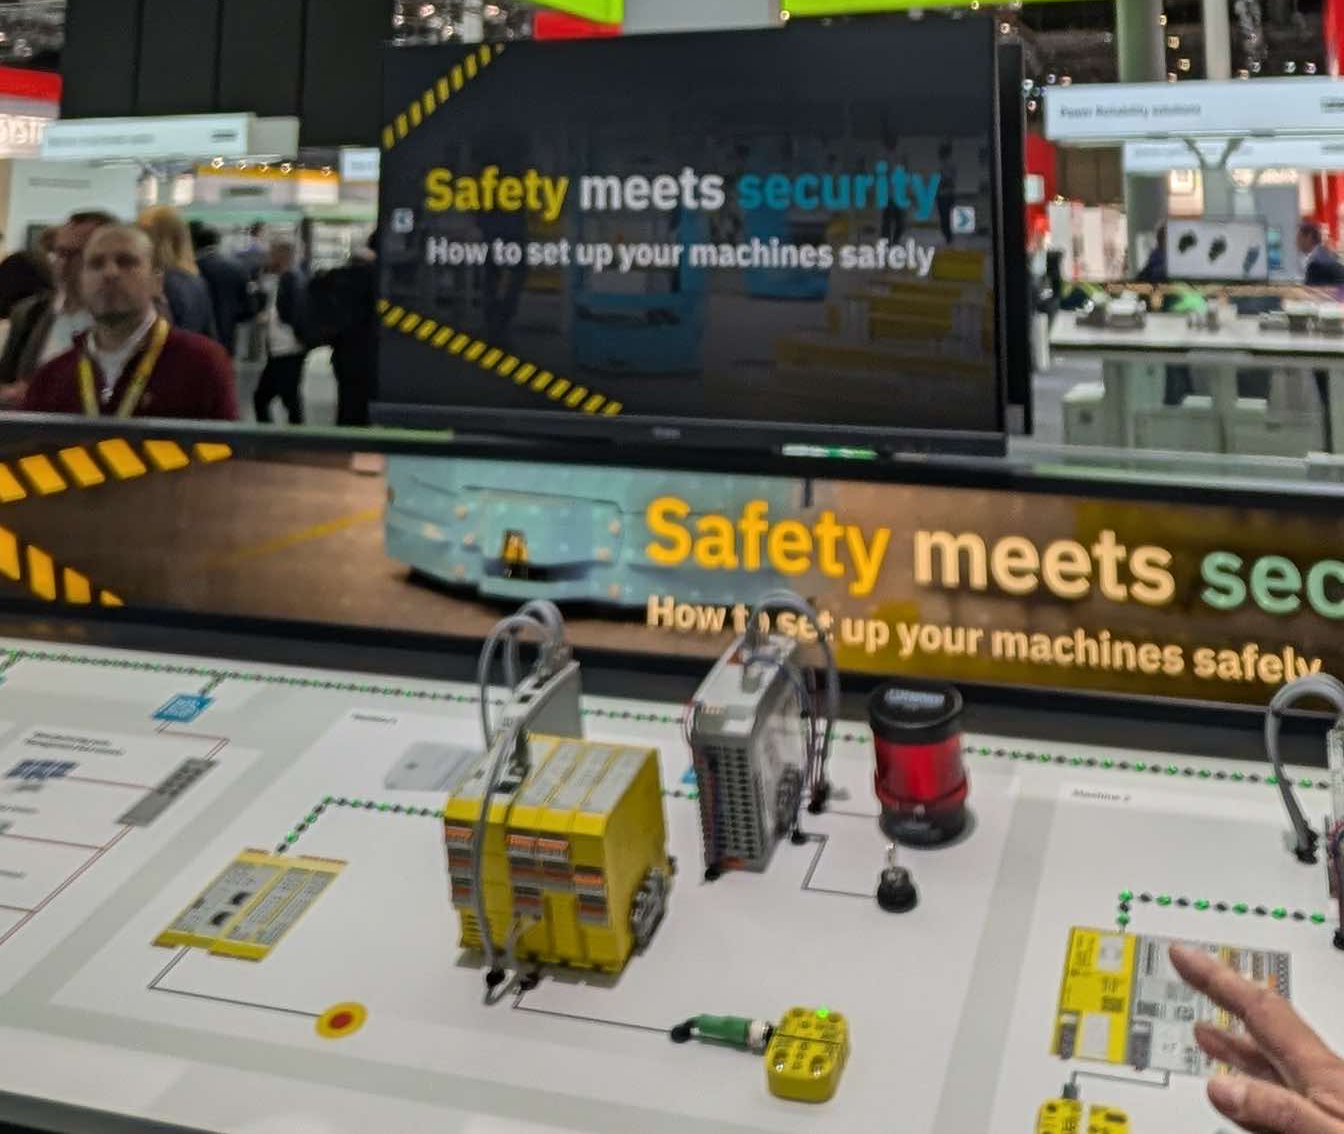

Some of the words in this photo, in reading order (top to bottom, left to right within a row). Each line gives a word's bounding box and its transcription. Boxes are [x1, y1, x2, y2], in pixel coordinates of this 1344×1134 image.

[424, 164, 569, 222] Safety
[579, 169, 725, 212] meets
[737, 161, 942, 219] security
[426, 236, 489, 266] How
[493, 236, 521, 266] to
[527, 237, 571, 268] set
[576, 240, 613, 274] up
[618, 240, 685, 275] your
[689, 236, 834, 270] machines
[840, 236, 935, 276] safely
[646, 496, 892, 596] Safety
[914, 528, 1175, 606] meets
[646, 593, 726, 634] How
[841, 616, 890, 653] up
[896, 621, 984, 659] your
[992, 623, 1185, 677] machines
